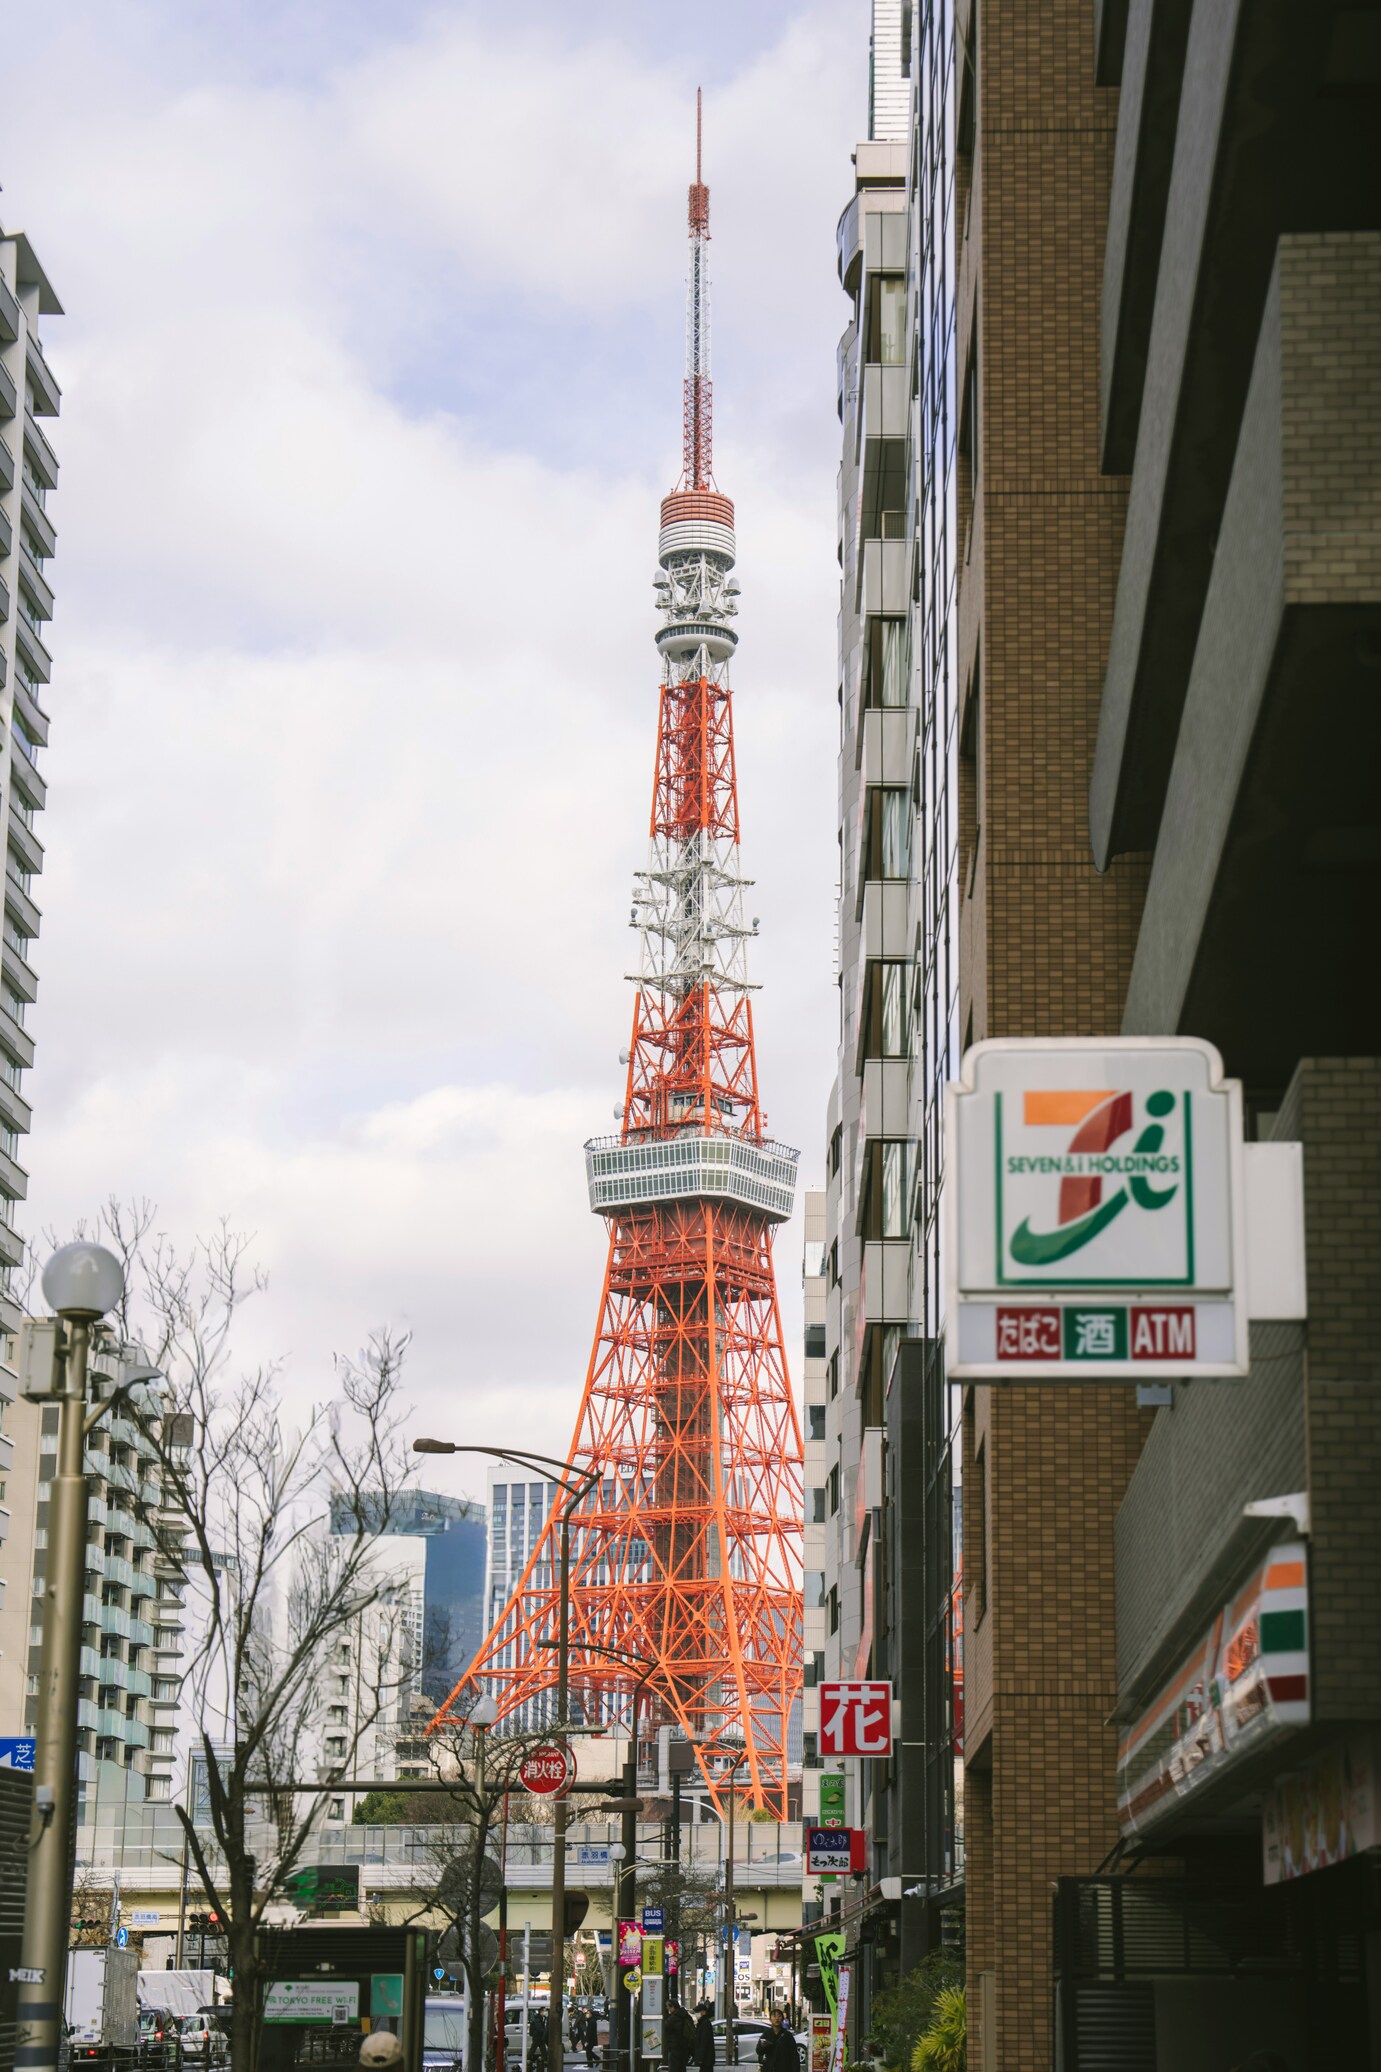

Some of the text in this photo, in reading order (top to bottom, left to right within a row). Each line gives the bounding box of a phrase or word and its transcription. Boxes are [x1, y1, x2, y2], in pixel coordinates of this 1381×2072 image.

[1089, 1156, 1180, 1173] HOLDINGS
[998, 1314, 1059, 1355] たばこ
[1076, 1314, 1116, 1355] 酒
[1134, 1313, 1194, 1354] ATM
[823, 1685, 889, 1752] 花
[15, 1743, 36, 1764] 芝
[523, 1760, 564, 1779] 消火栓
[581, 1851, 608, 1859] 赤羽橋
[811, 1855, 849, 1868] もつ次郎
[278, 1996, 308, 2004] TOKYO
[310, 1996, 333, 2004] FREE
